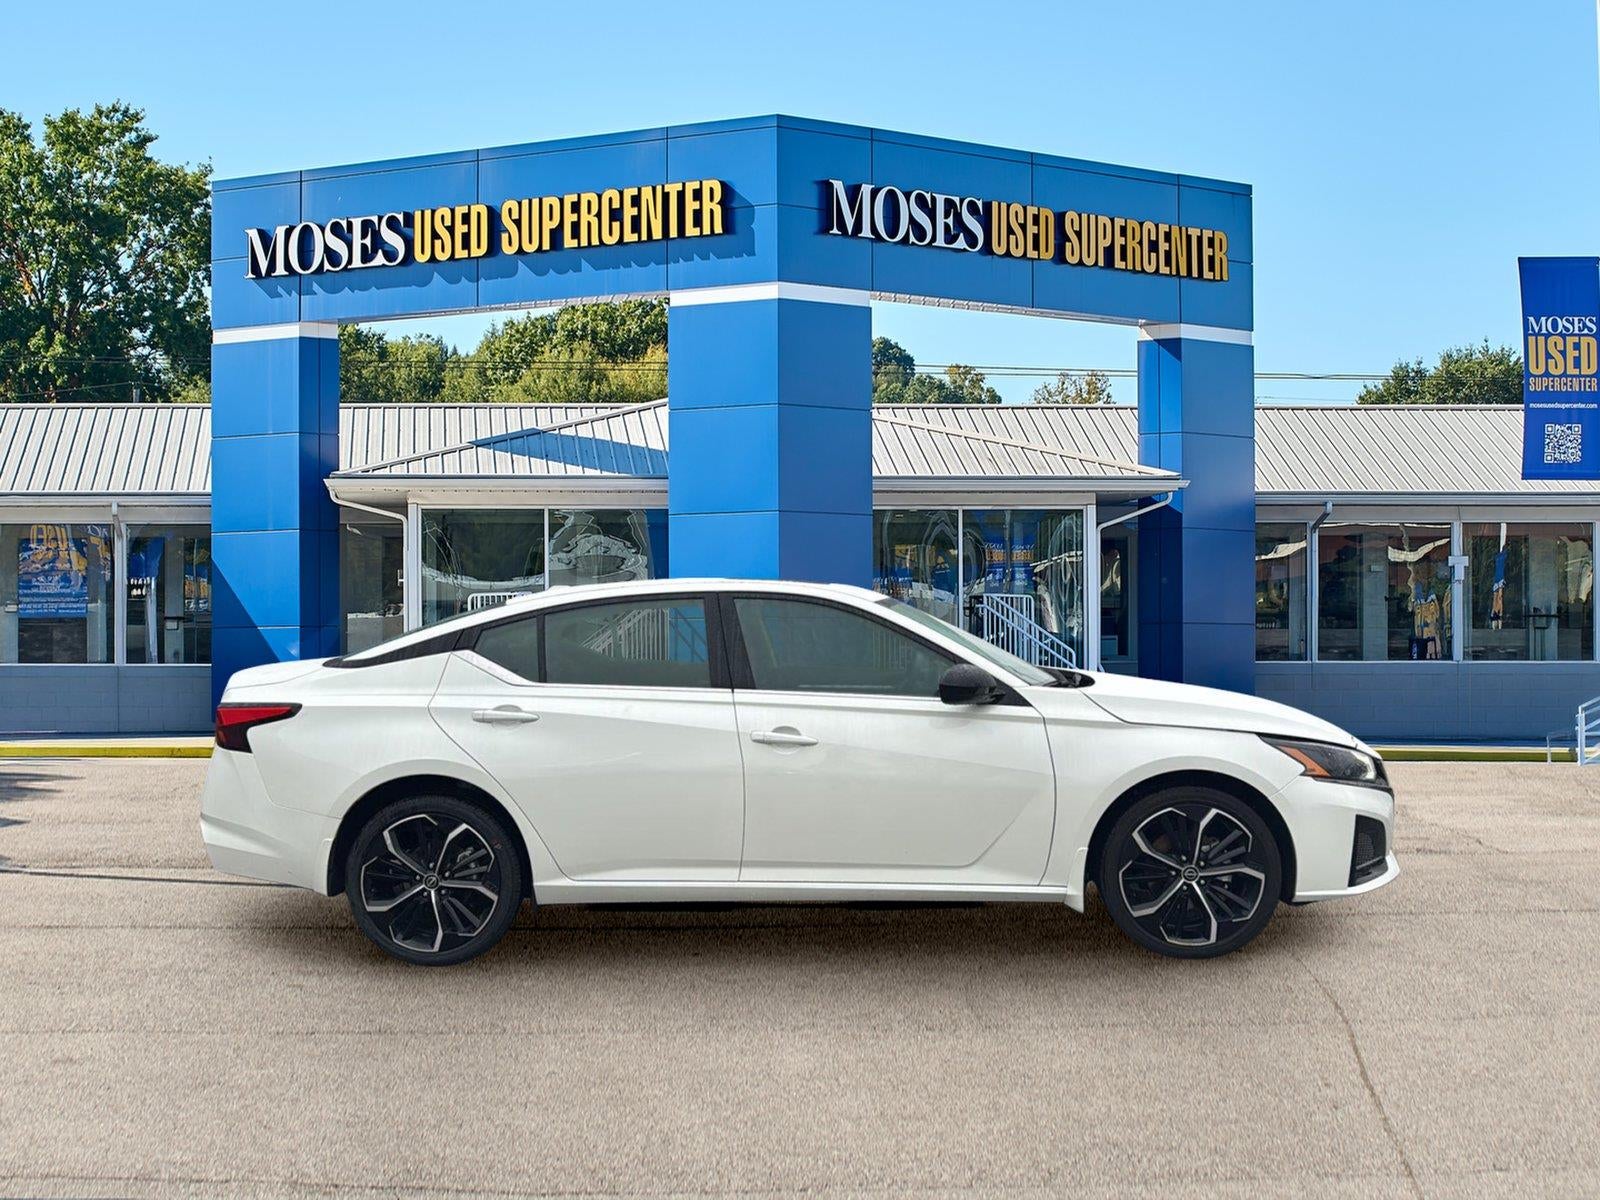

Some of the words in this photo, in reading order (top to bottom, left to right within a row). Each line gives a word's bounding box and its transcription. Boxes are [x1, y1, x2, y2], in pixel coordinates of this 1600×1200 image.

[244, 211, 406, 279] MOSES
[413, 204, 488, 264] USED
[500, 179, 723, 255] SUPERCENTER
[828, 179, 984, 252] MOSES
[991, 200, 1054, 260] USED
[1064, 210, 1229, 281] SUPERCENTER
[1528, 316, 1596, 333] MOSES
[1529, 335, 1597, 374] USED
[1529, 378, 1597, 391] SUPERCENTER
